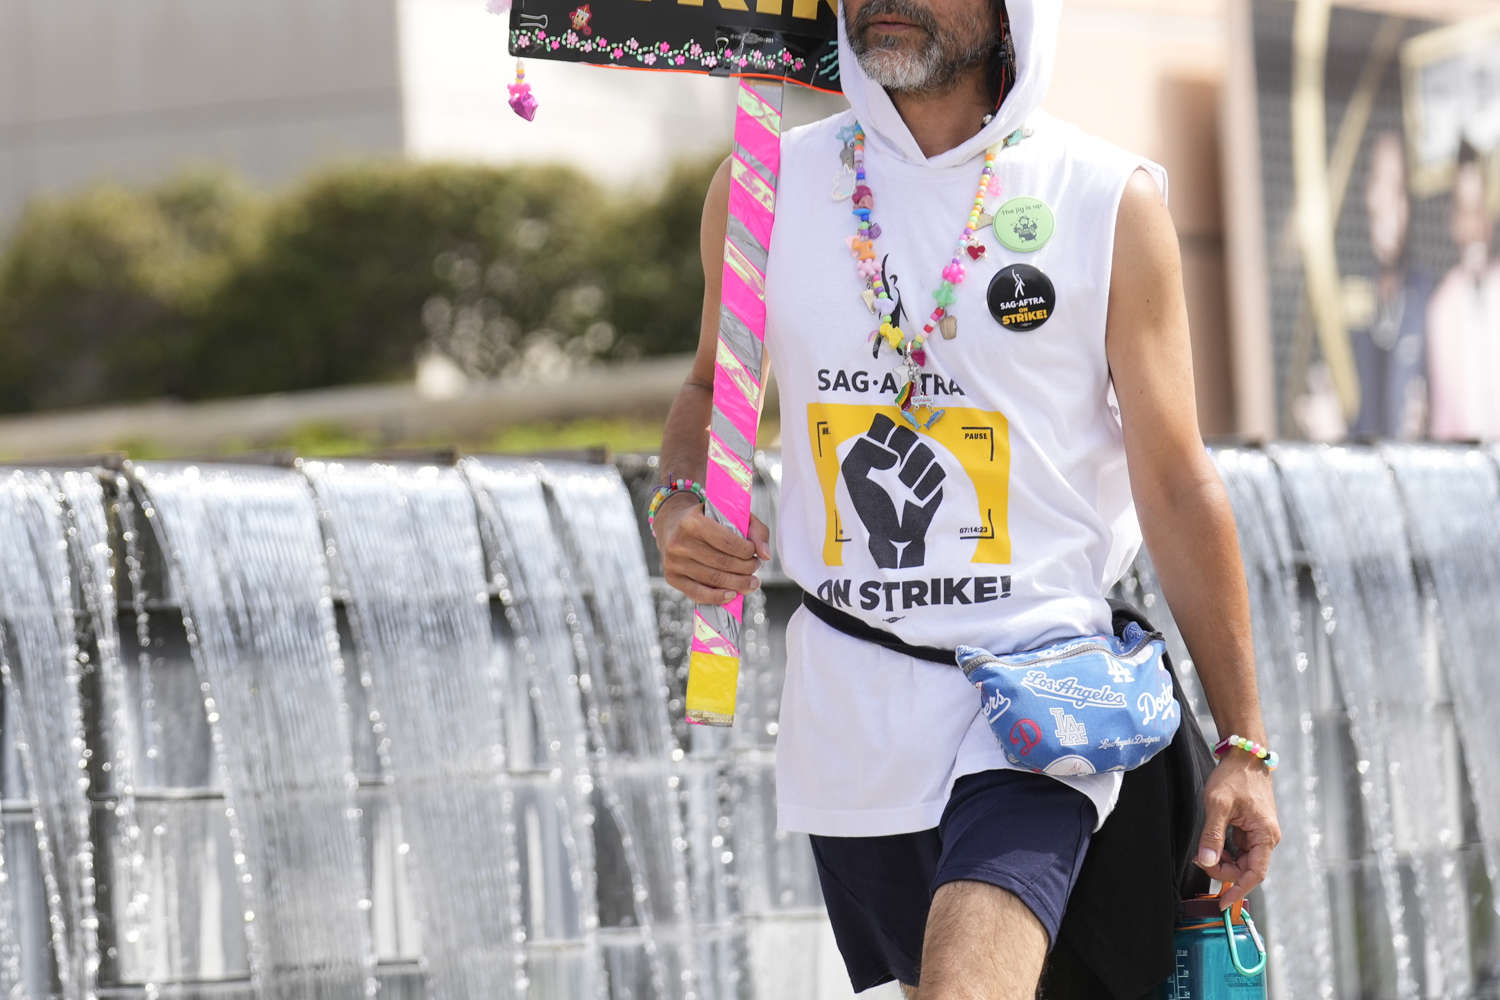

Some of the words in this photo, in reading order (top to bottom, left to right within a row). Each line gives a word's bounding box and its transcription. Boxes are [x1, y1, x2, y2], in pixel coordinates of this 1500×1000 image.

[1001, 208, 1015, 216] The
[1002, 309, 1048, 325] STRIKE!
[964, 432, 988, 440] PAUSE
[959, 526, 989, 534] 07:14:23
[859, 575, 1011, 612] STRIKE!
[1023, 671, 1055, 691] Los
[1053, 677, 1125, 709] Angeles
